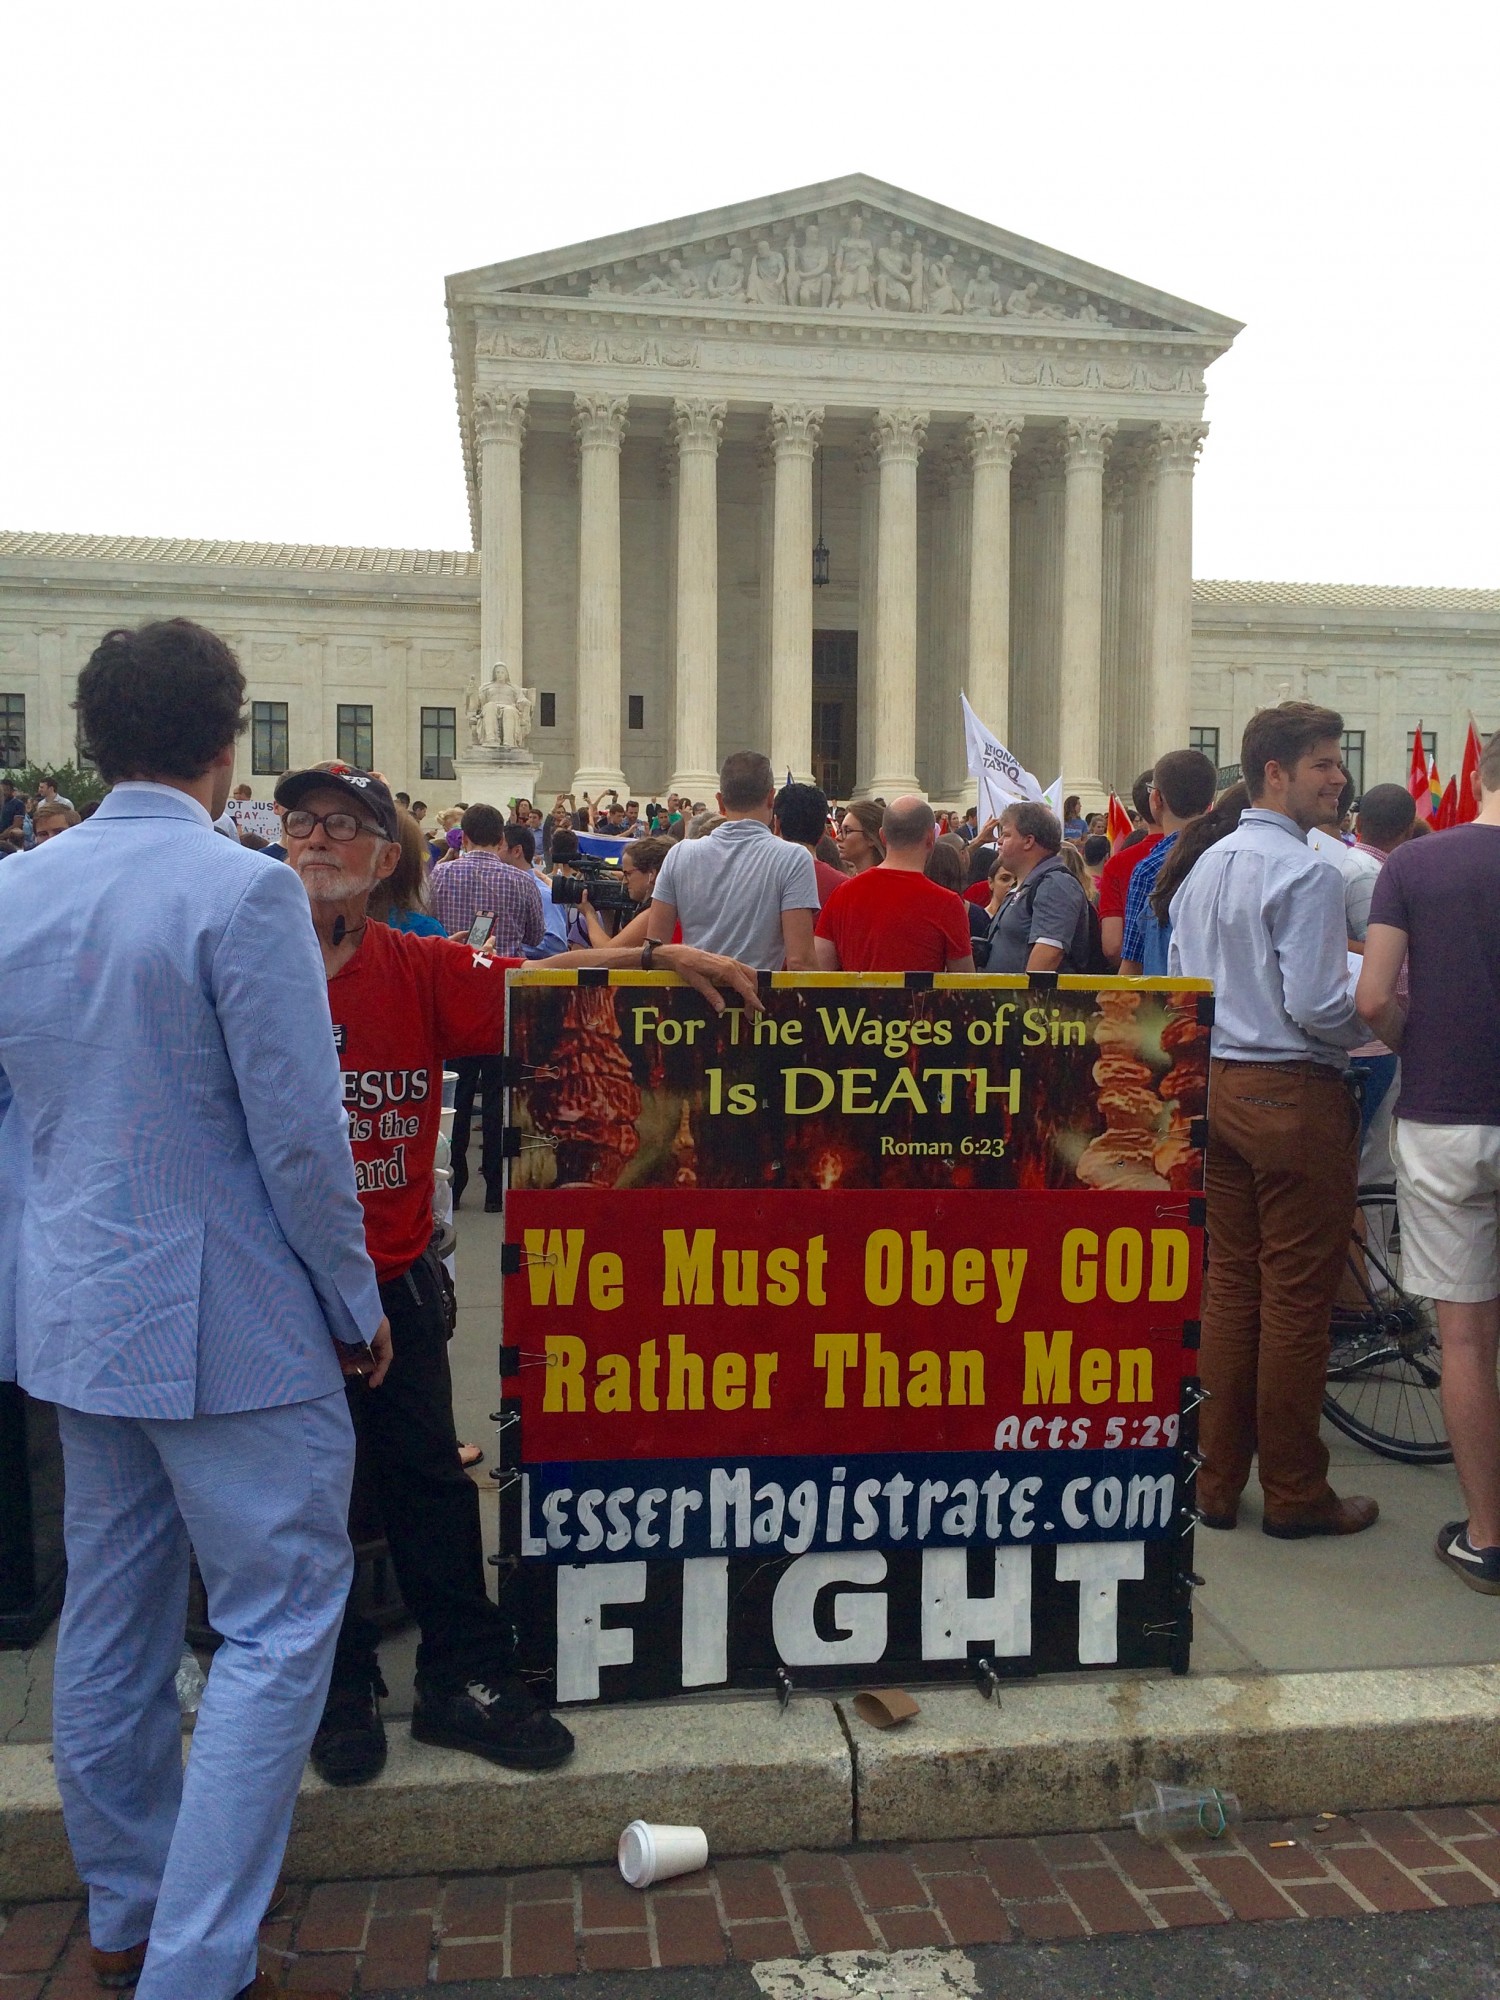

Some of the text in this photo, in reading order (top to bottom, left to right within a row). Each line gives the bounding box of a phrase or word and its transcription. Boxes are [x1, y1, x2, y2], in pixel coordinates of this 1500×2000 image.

[227, 801, 274, 811] OT JUS
[633, 1003, 1087, 1059] For The Wages of Sin
[339, 1069, 429, 1110] ESUS
[706, 1067, 1022, 1115] Is DEATH
[349, 1109, 419, 1141] is the
[880, 1136, 1006, 1159] Roman 6:23
[355, 1145, 407, 1192] ard
[524, 1227, 1190, 1323] We Must Obey GOD
[543, 1331, 1154, 1412] Rather Than Men
[1103, 1413, 1180, 1449] 5:29
[556, 1541, 1145, 1703] FIGHT
